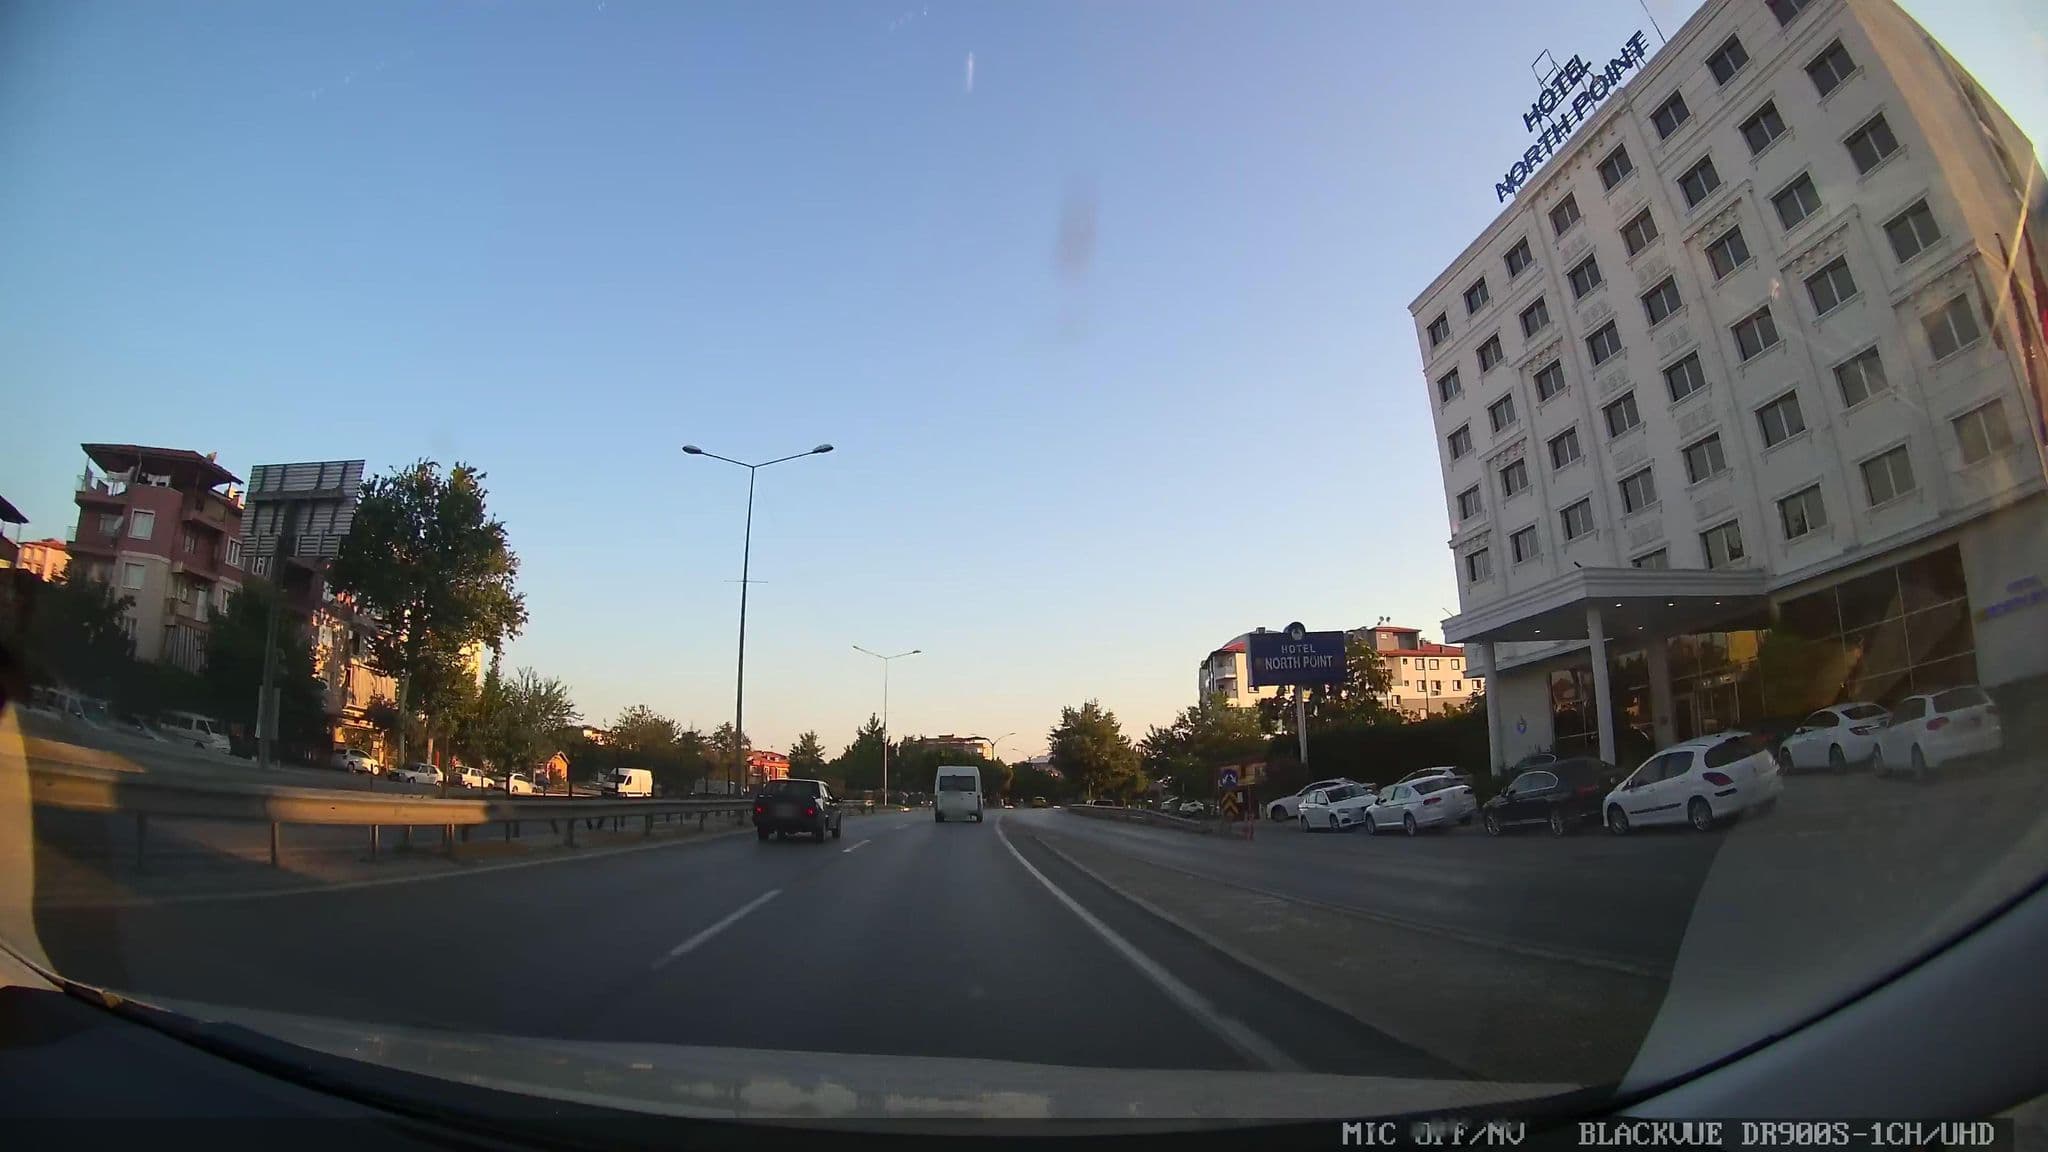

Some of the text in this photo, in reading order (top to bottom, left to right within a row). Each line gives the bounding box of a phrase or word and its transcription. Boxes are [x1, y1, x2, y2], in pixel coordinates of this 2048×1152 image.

[1523, 54, 1591, 132] HOTEL
[1495, 30, 1649, 203] NORTH POINT
[1265, 655, 1333, 670] NORTH POINT
[1281, 644, 1316, 654] HOTEL
